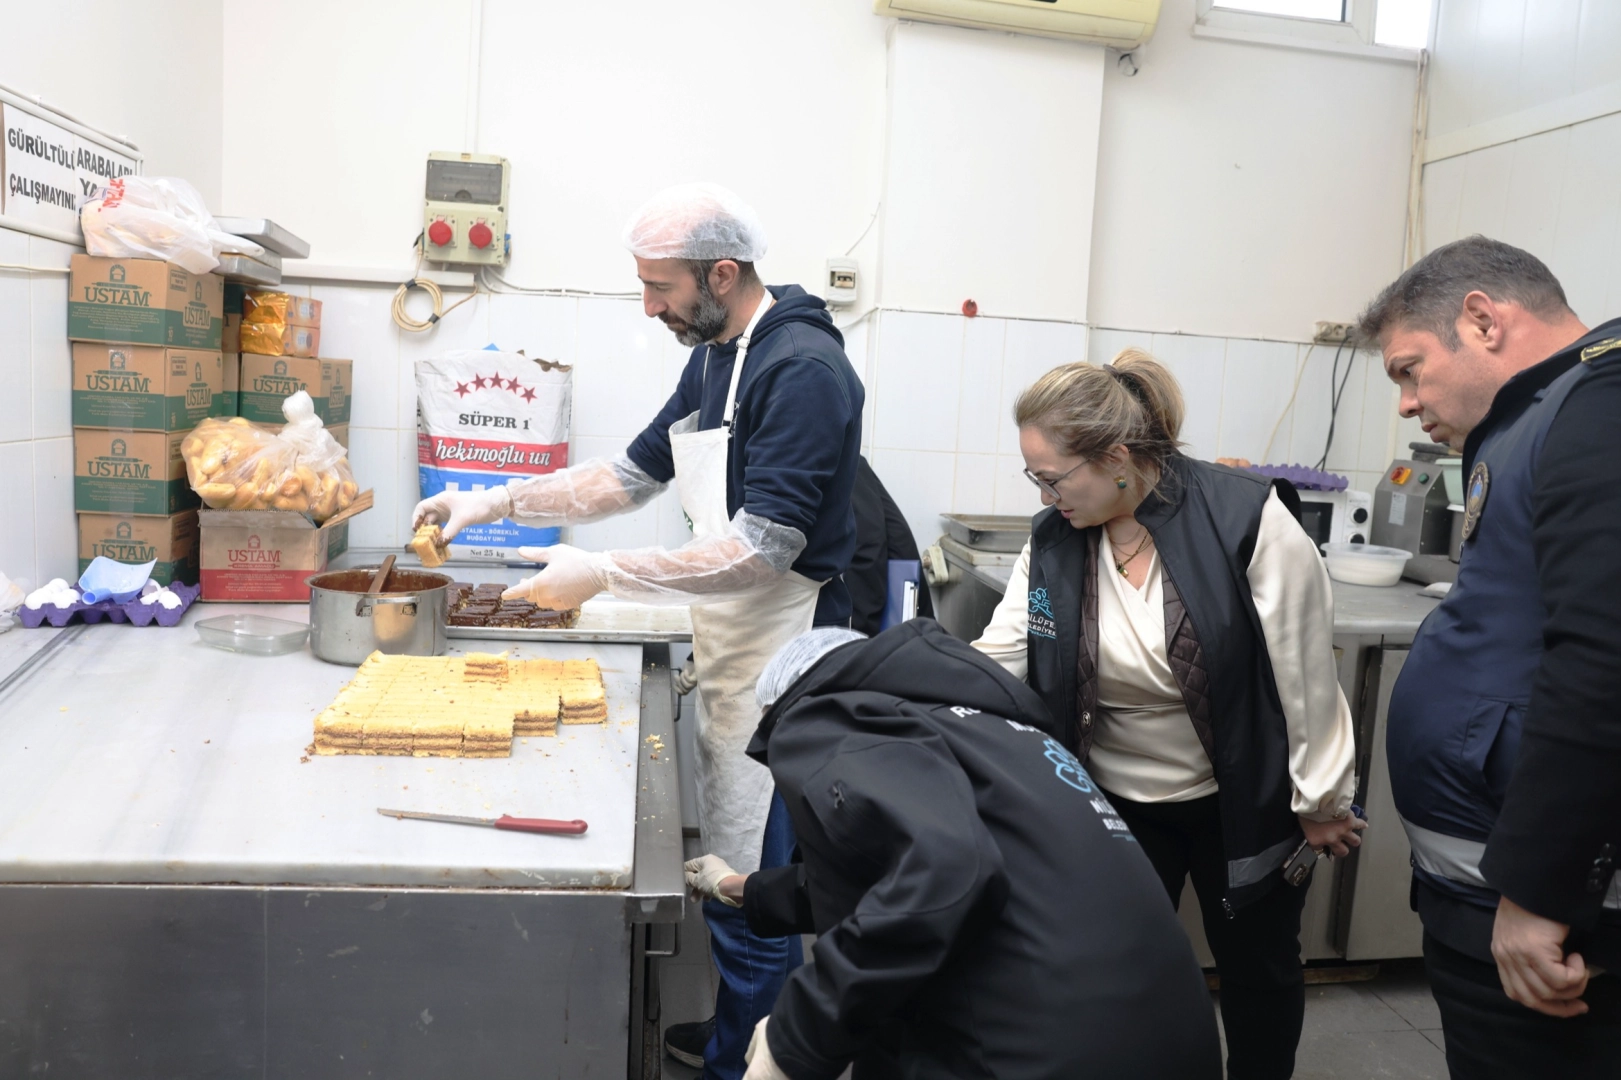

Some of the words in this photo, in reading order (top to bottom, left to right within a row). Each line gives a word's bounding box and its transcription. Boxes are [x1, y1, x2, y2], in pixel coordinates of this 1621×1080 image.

[84, 286, 150, 307] USTAM
[184, 306, 211, 327] USTAM
[86, 374, 150, 393] USTAM
[253, 378, 307, 395] USTAM
[186, 388, 211, 406] USTAM
[459, 410, 517, 429] SÜPER
[523, 419, 530, 430] 1
[435, 439, 525, 469] hekimoğlu
[528, 450, 551, 467] un
[87, 460, 150, 479] USTAM
[460, 527, 484, 535] STALIK
[92, 543, 156, 561] USTAM
[227, 549, 281, 563] USTAM
[483, 549, 494, 557] 25
[496, 550, 505, 559] kg
